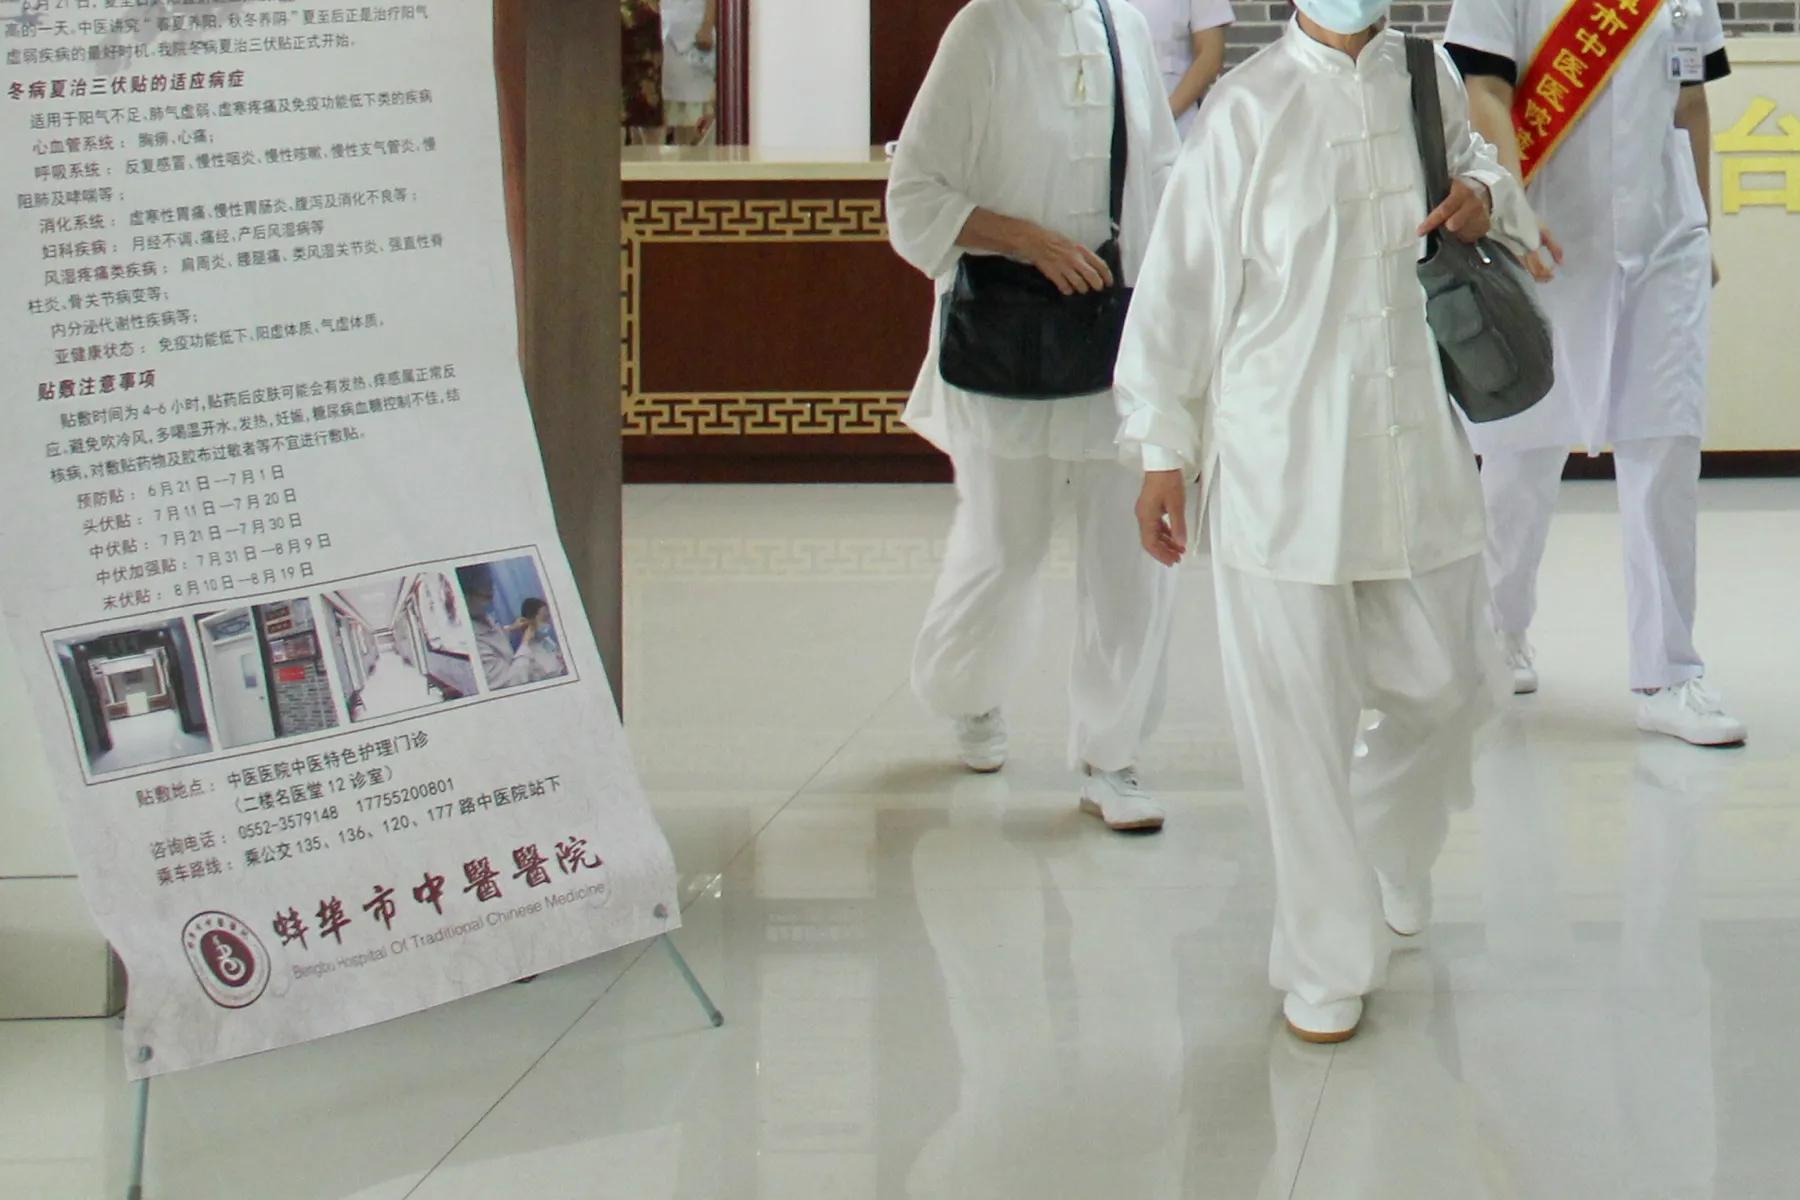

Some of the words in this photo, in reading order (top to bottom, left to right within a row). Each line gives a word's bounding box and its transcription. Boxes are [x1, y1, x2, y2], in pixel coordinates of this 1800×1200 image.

[8, 69, 245, 100] 冬病夏治三伏贴的适应病症
[38, 369, 156, 401] 贴敷注意事项
[238, 805, 339, 840] 0552-3579148
[357, 777, 456, 813] 17755200801
[272, 835, 604, 951] 蚌埠市中醫醫院
[337, 948, 388, 969] Hospital
[411, 919, 484, 949] Traditional
[486, 902, 543, 927] Chinese
[545, 881, 606, 910] Medicine
